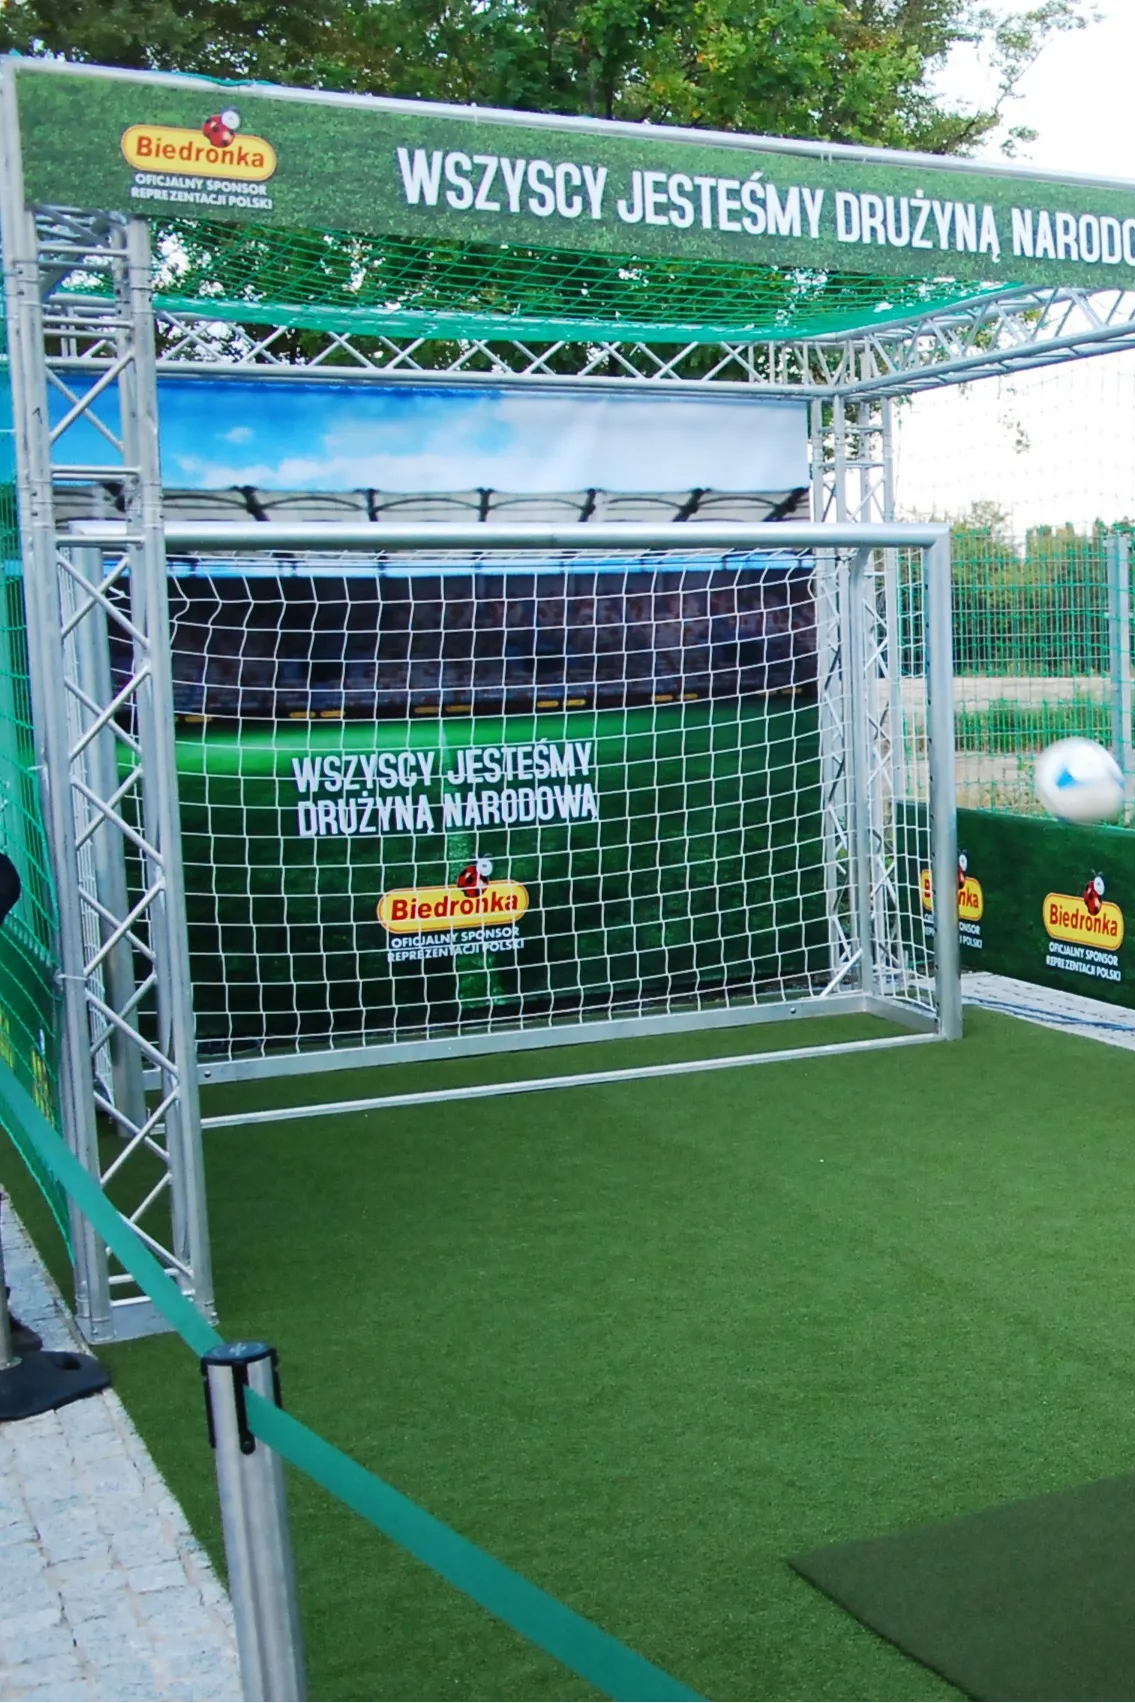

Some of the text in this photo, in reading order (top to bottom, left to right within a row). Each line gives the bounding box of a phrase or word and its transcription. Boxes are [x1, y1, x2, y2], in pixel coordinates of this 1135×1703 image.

[136, 136, 265, 168] Biedronka
[135, 173, 267, 195] OFICJALNY SPONSOR
[131, 187, 272, 209] REPREZENTACJI POLSKI
[397, 147, 608, 219] WSZYSCY
[617, 166, 825, 239] JESTEŚMY
[836, 189, 1000, 263] DRUŻYNĄ
[292, 738, 592, 792] WSZYSCY JESTEŚMY
[298, 783, 598, 838] DRUŻYNĄ NARODOWĄ
[392, 892, 518, 920] Biedronka
[960, 922, 980, 935] ONSOR
[1050, 904, 1118, 936] Biedronka
[391, 926, 520, 948] OFICJALNY SPONSOR
[963, 936, 982, 948] POLSKI
[388, 939, 524, 962] REPREZENTACJI POLSKI
[1049, 942, 1118, 966] OFICJALNY SPONSOR
[1046, 955, 1121, 981] REPREZENTACJI POLSKI
